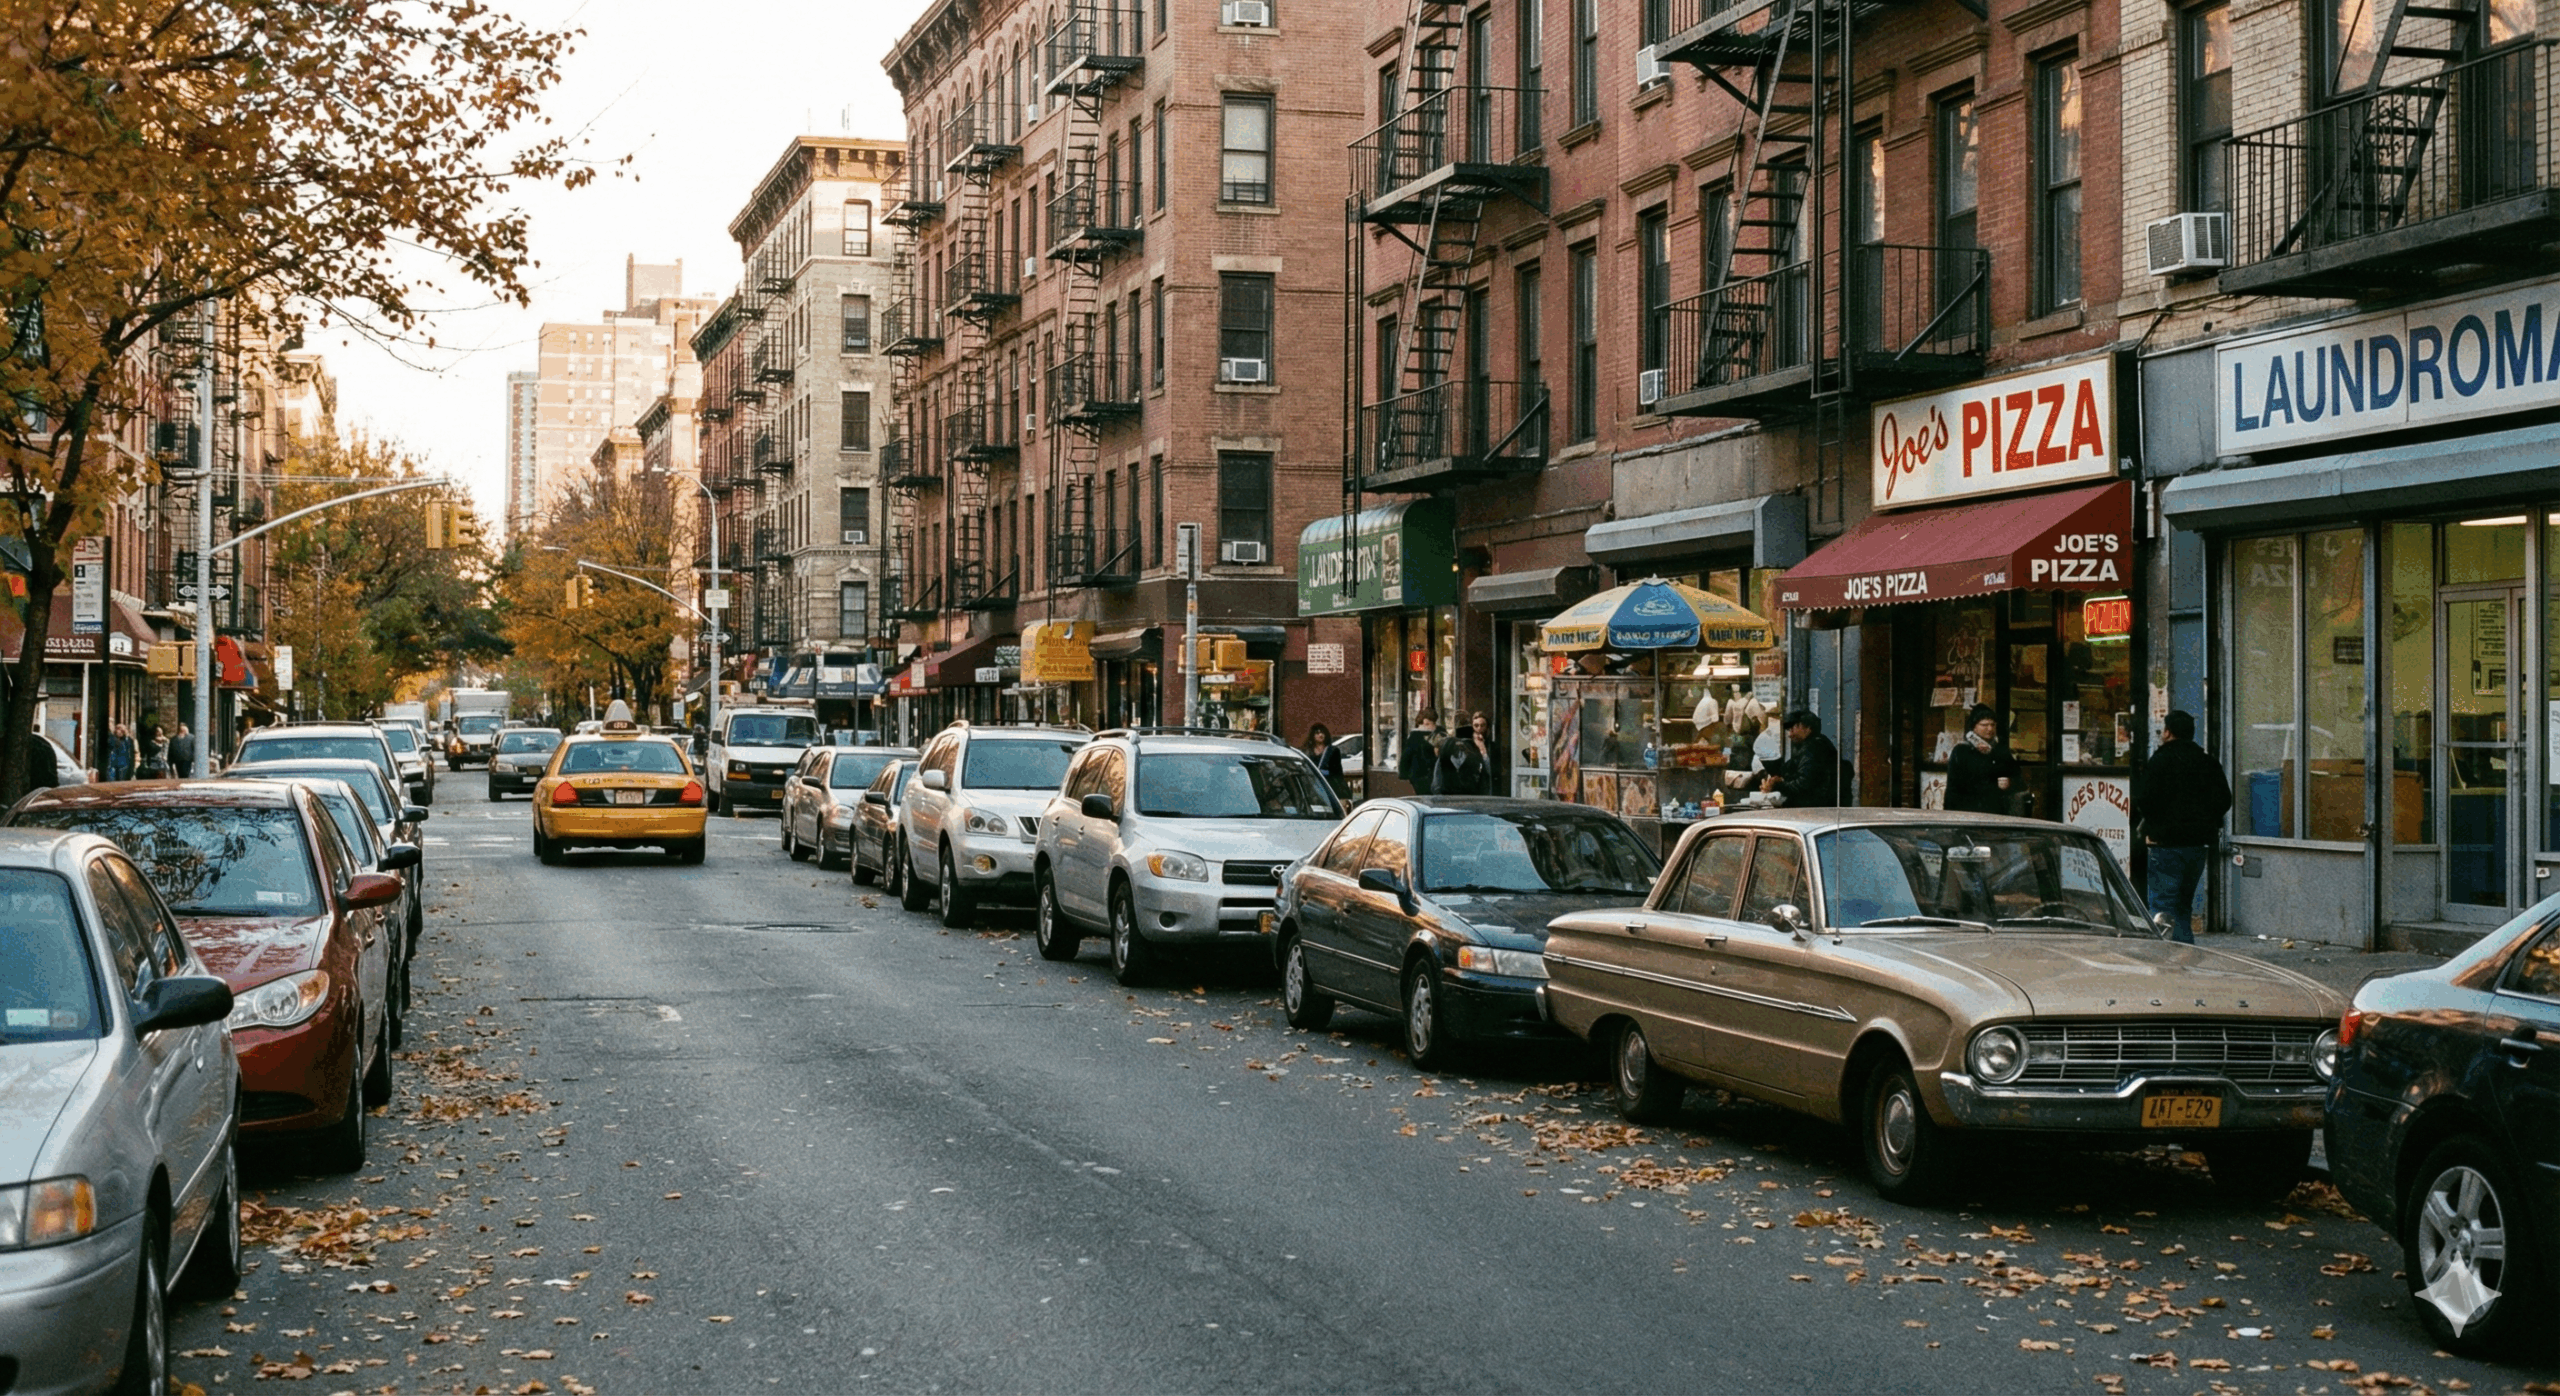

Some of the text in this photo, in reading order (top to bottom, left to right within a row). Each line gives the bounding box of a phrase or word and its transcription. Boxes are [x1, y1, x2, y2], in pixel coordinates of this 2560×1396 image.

[1880, 378, 2104, 500] Joe's PIZZA
[2054, 534, 2119, 553] JOE'S
[2031, 559, 2119, 582] PIZZA
[1844, 571, 1929, 600] JOE'S PIZZA
[2098, 781, 2129, 817] PIZZA
